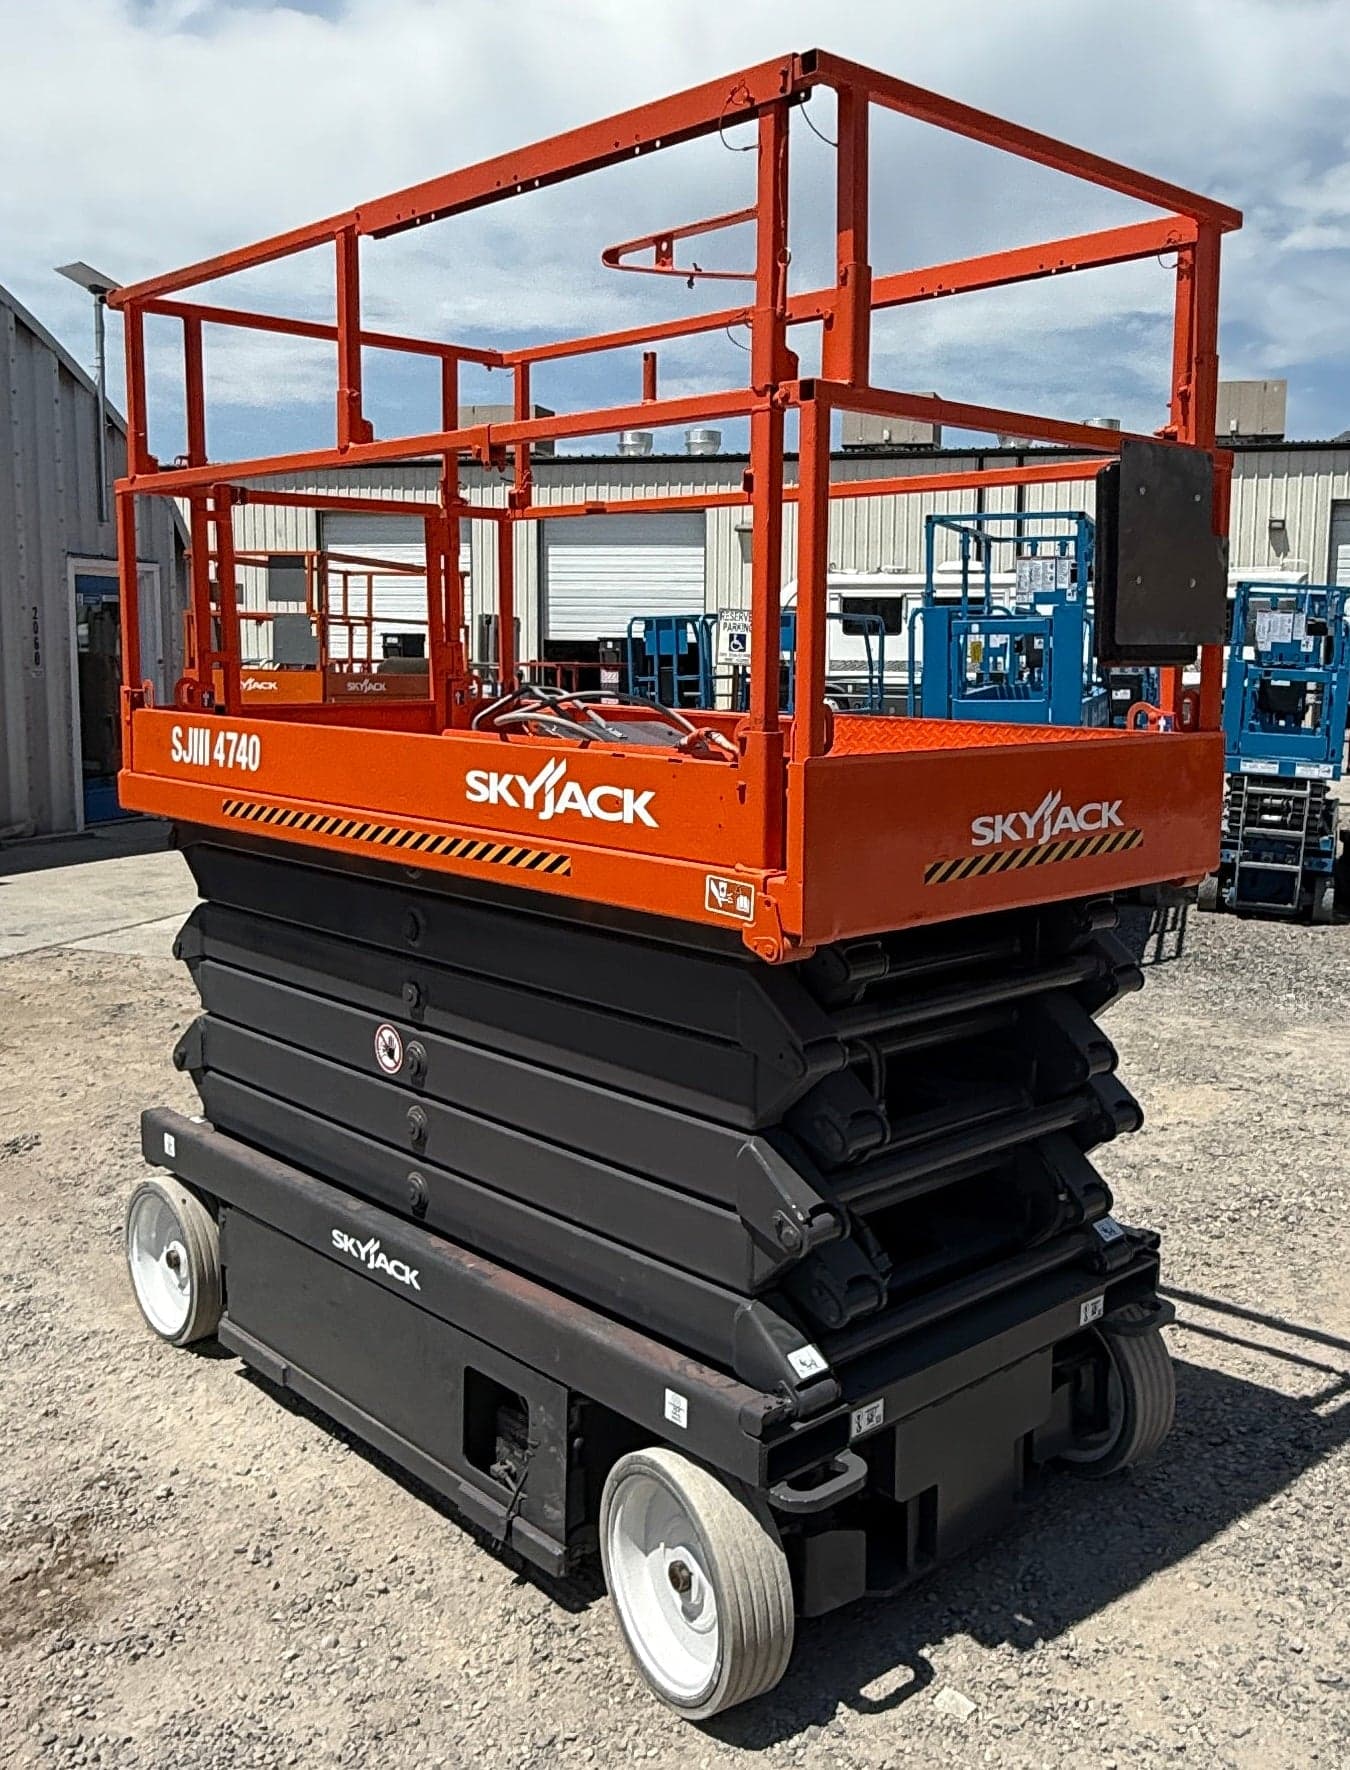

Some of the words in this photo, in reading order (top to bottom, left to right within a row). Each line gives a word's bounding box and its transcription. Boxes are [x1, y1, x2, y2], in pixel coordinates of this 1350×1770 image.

[720, 611, 752, 622] RESERVE
[241, 676, 278, 691] YJACK
[346, 678, 387, 693] SKYJACK
[171, 725, 210, 767] SJIII
[213, 730, 261, 772] 4740
[465, 757, 659, 828] SKYJACK
[971, 789, 1124, 846] SKYJACK
[331, 1228, 421, 1291] SKYJACK
